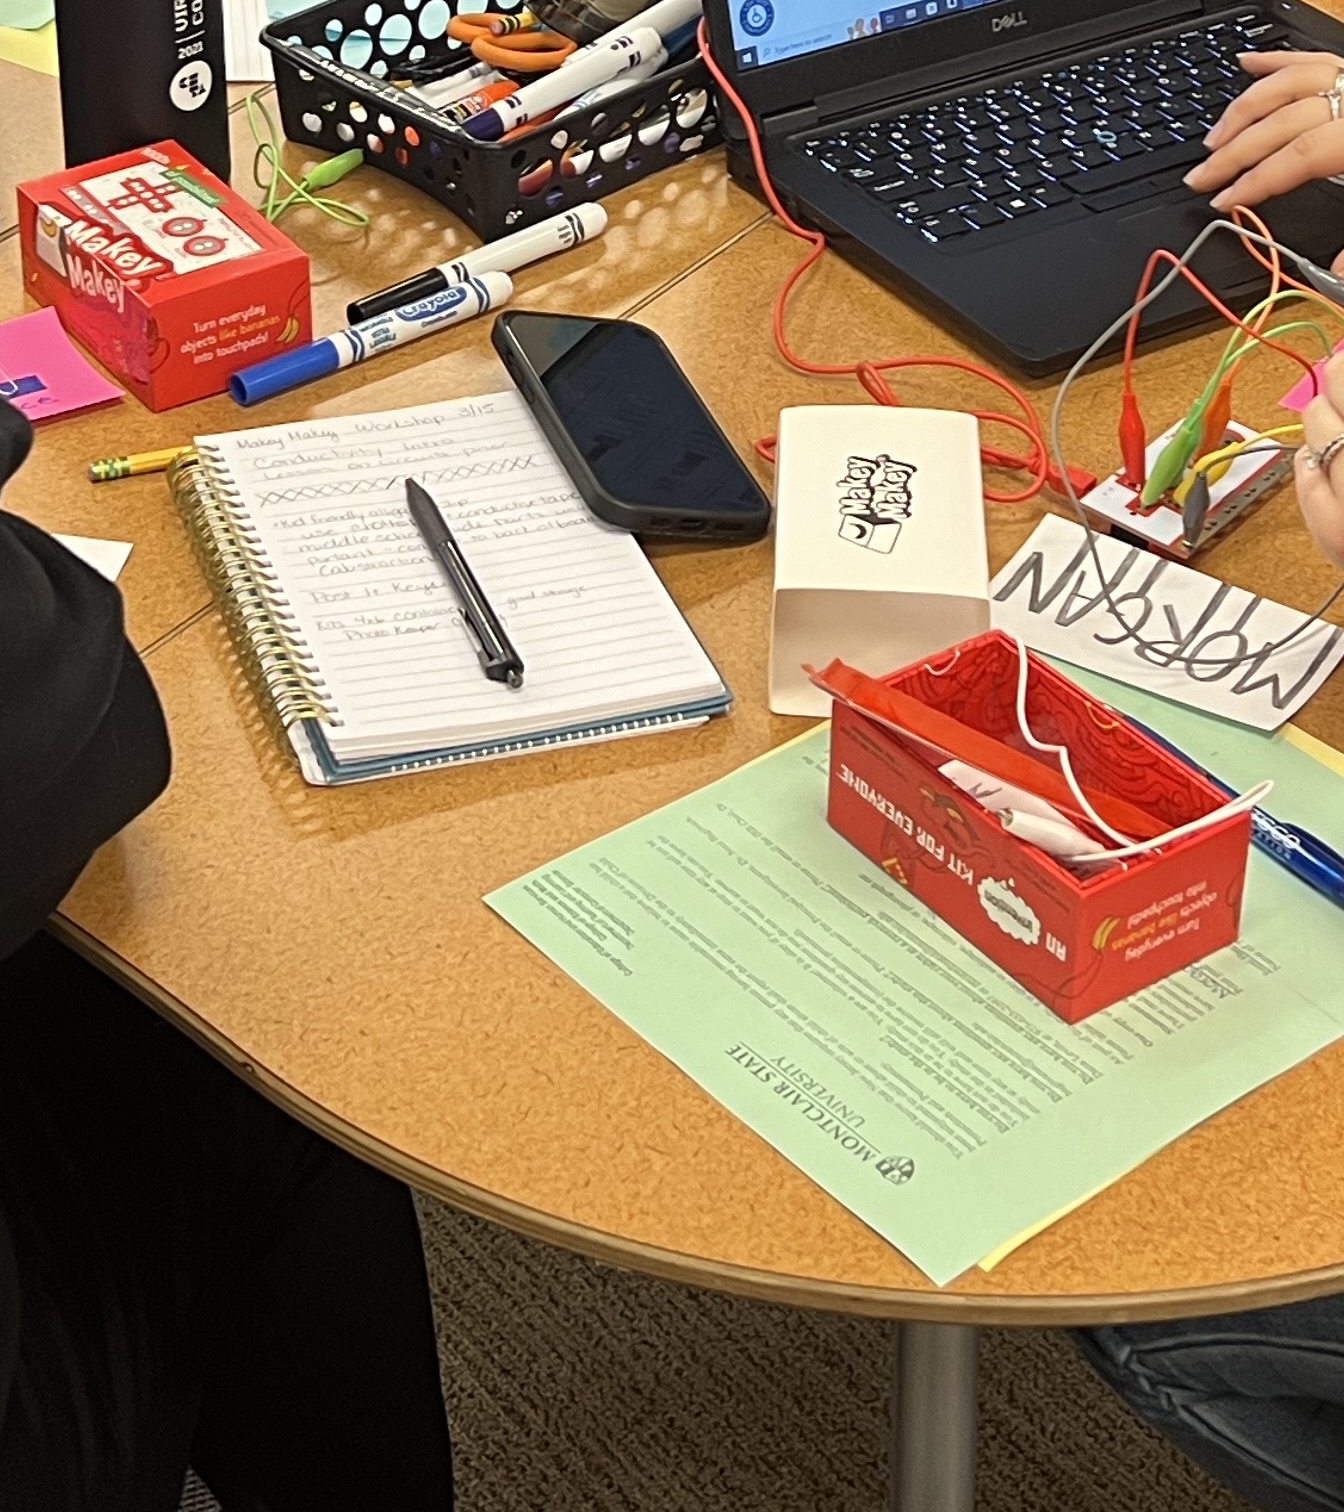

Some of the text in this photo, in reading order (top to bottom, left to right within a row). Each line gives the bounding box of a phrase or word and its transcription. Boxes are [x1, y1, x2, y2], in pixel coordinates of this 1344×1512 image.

[992, 12, 1028, 33] DELL
[66, 220, 163, 275] Makey
[67, 254, 125, 313] Makey
[401, 288, 460, 317] Crayola
[180, 314, 280, 355] objects like bananas
[193, 304, 266, 334] Turn everyday
[193, 331, 269, 365] into touchpads!
[458, 402, 495, 419] 3/15
[253, 445, 383, 470] Conductivity
[836, 455, 881, 516] Makey
[874, 458, 918, 519] Makey
[992, 535, 1343, 709] MORGAN
[836, 764, 914, 835] EVERYONE
[916, 825, 945, 863] FOR
[947, 853, 974, 886] KIT
[724, 1040, 778, 1087] STATE
[769, 1050, 867, 1131] UNIVERSITY
[770, 1077, 879, 1167] MONTCLAIR
